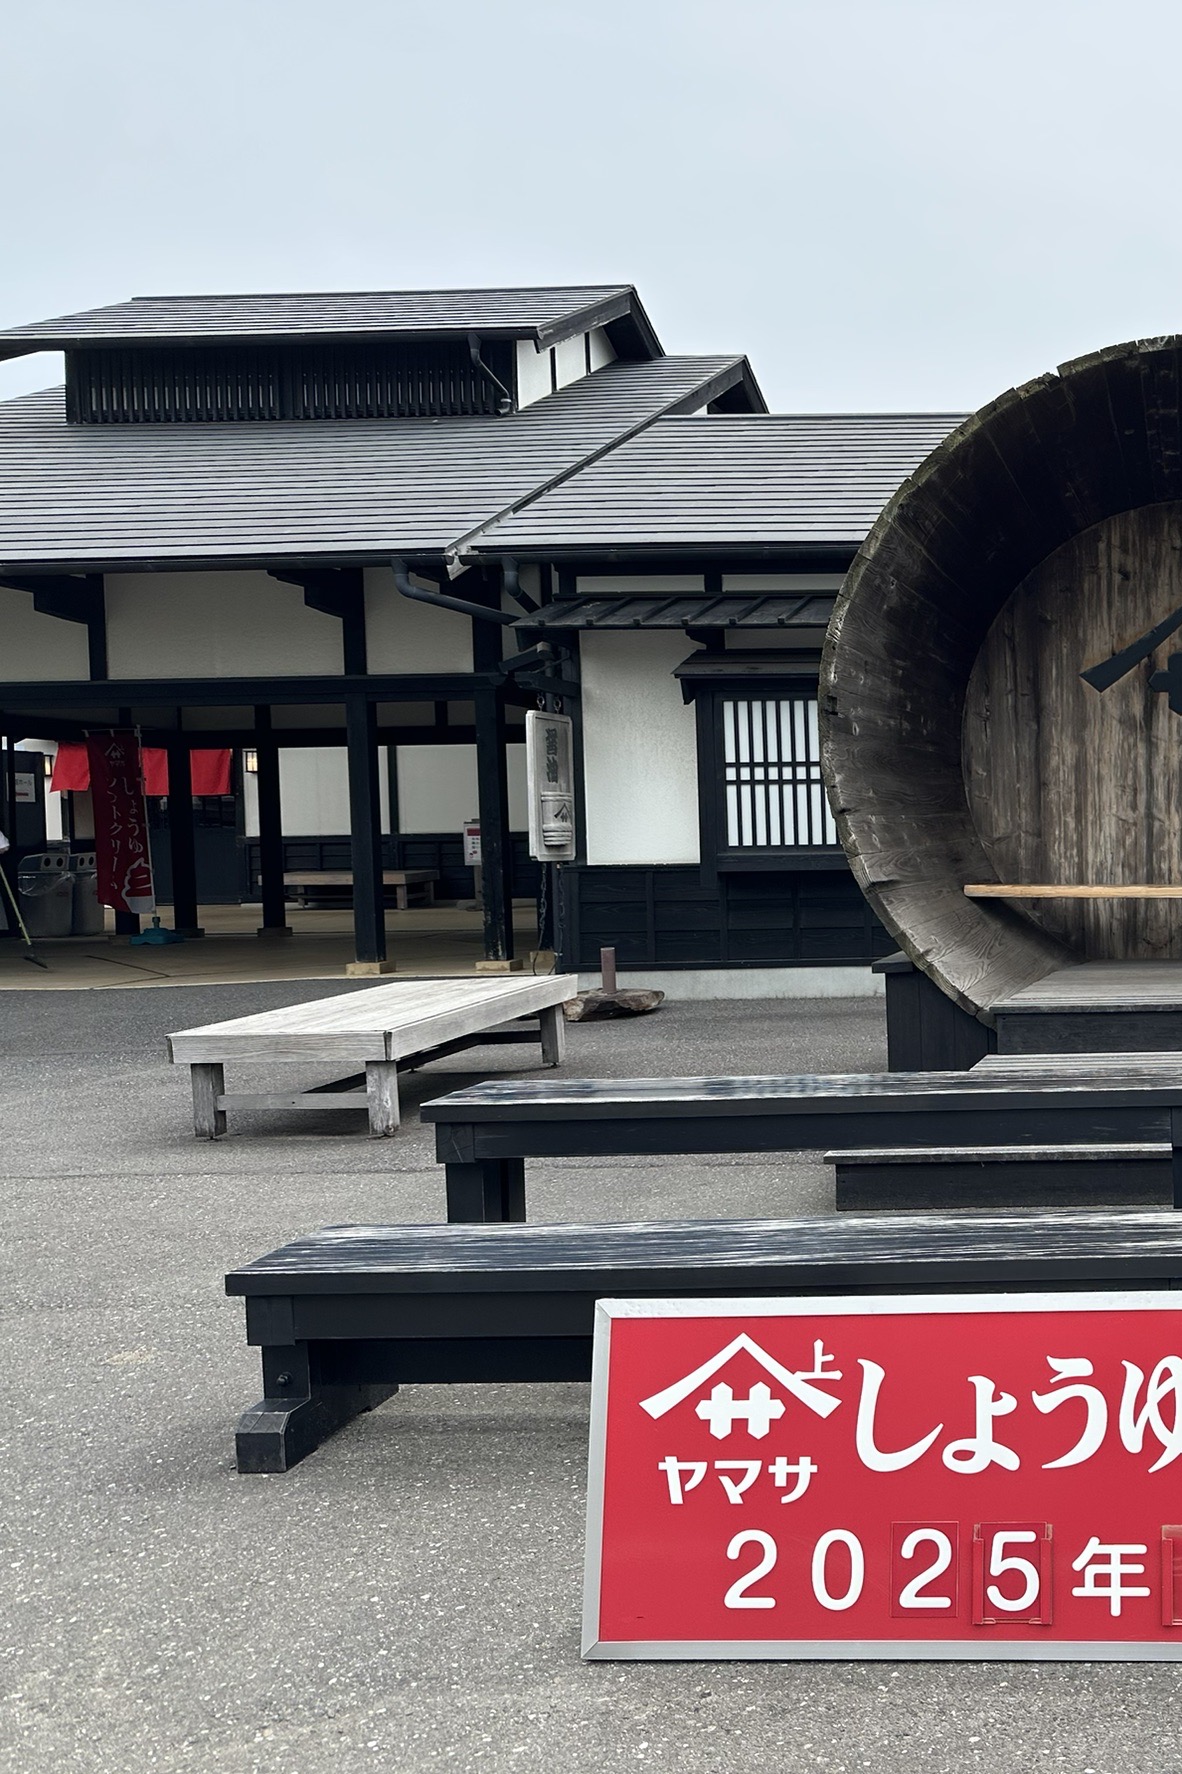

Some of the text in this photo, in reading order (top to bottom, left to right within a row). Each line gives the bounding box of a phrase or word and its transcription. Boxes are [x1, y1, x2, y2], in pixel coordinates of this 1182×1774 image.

[122, 776, 144, 854] しょうゆ
[658, 1456, 818, 1505] ヤマサ
